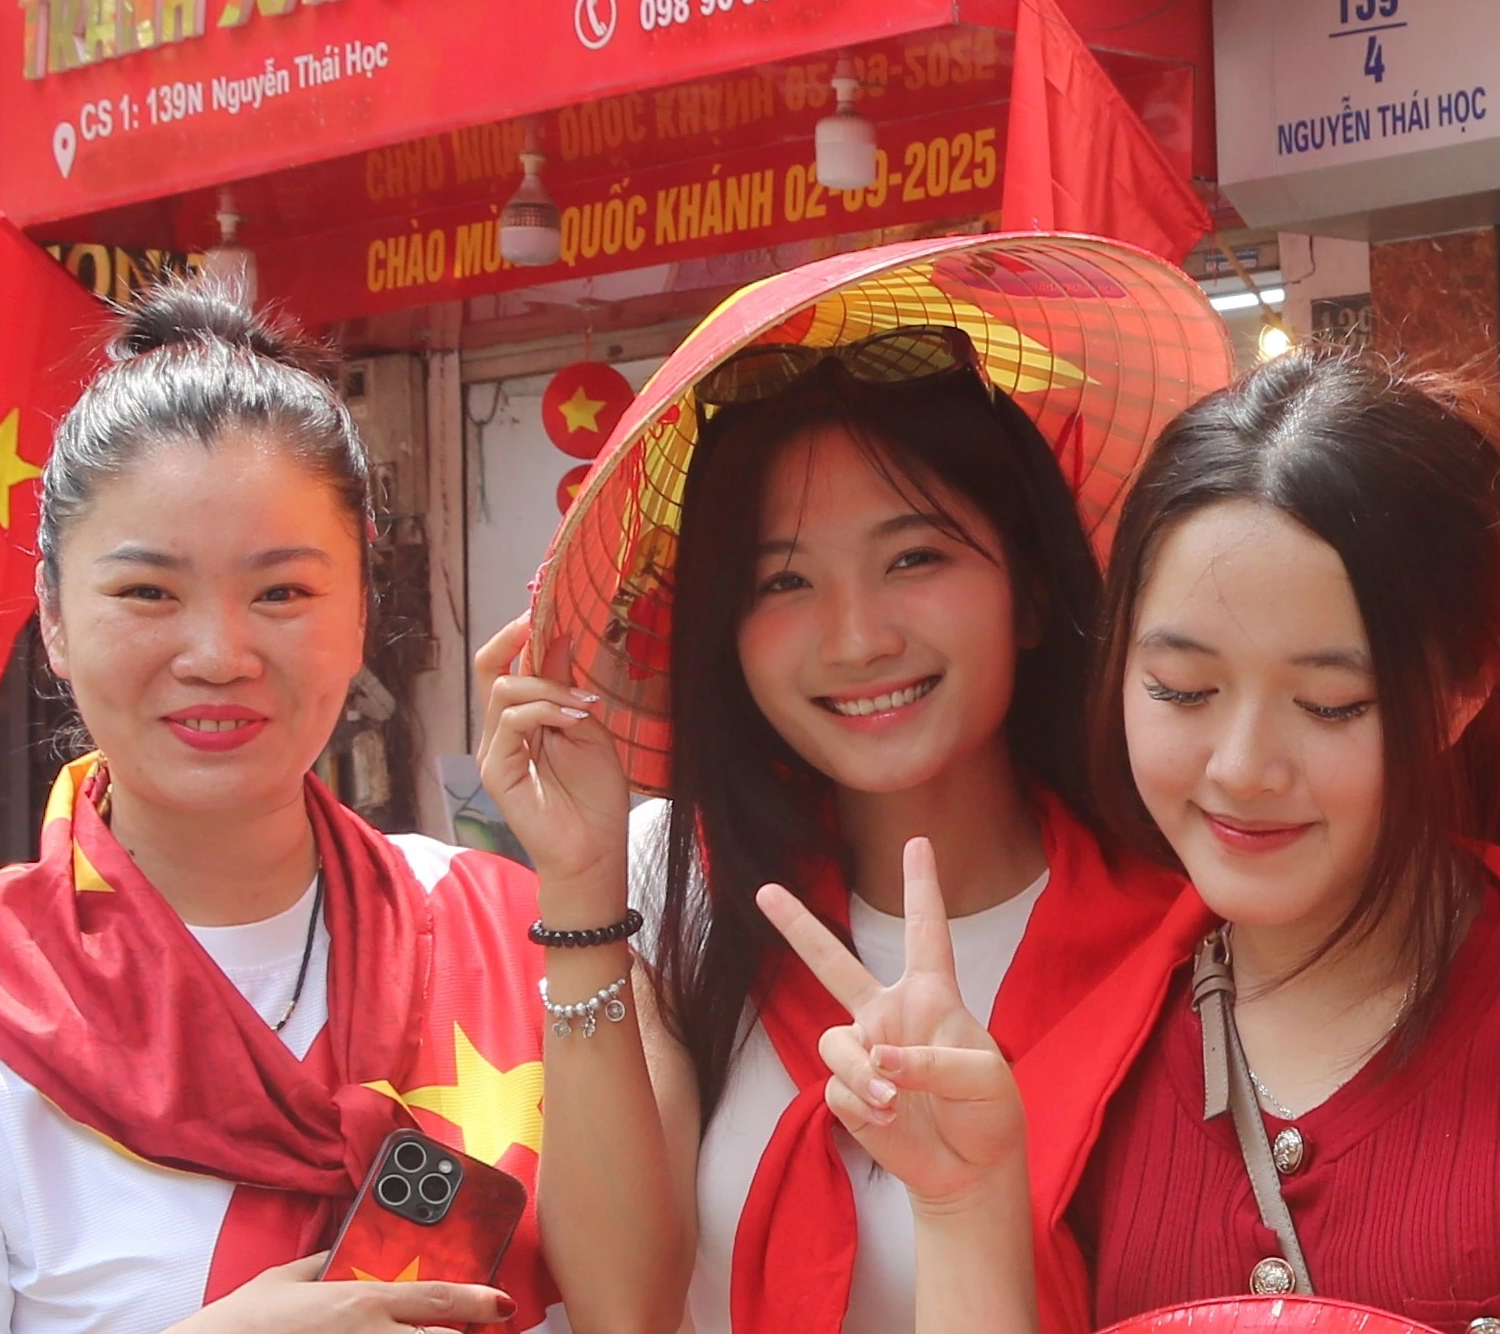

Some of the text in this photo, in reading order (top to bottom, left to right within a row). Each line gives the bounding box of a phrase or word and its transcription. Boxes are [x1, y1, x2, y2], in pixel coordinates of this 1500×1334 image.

[79, 37, 391, 144] CS 1: 139N Nguyễn Thái Học
[1363, 34, 1386, 84] 4
[1277, 85, 1488, 156] NGUYỄN THÁI HỌC
[366, 218, 445, 294] CHÀO
[560, 176, 648, 268] QUỐC
[654, 164, 775, 246] KHÁNH
